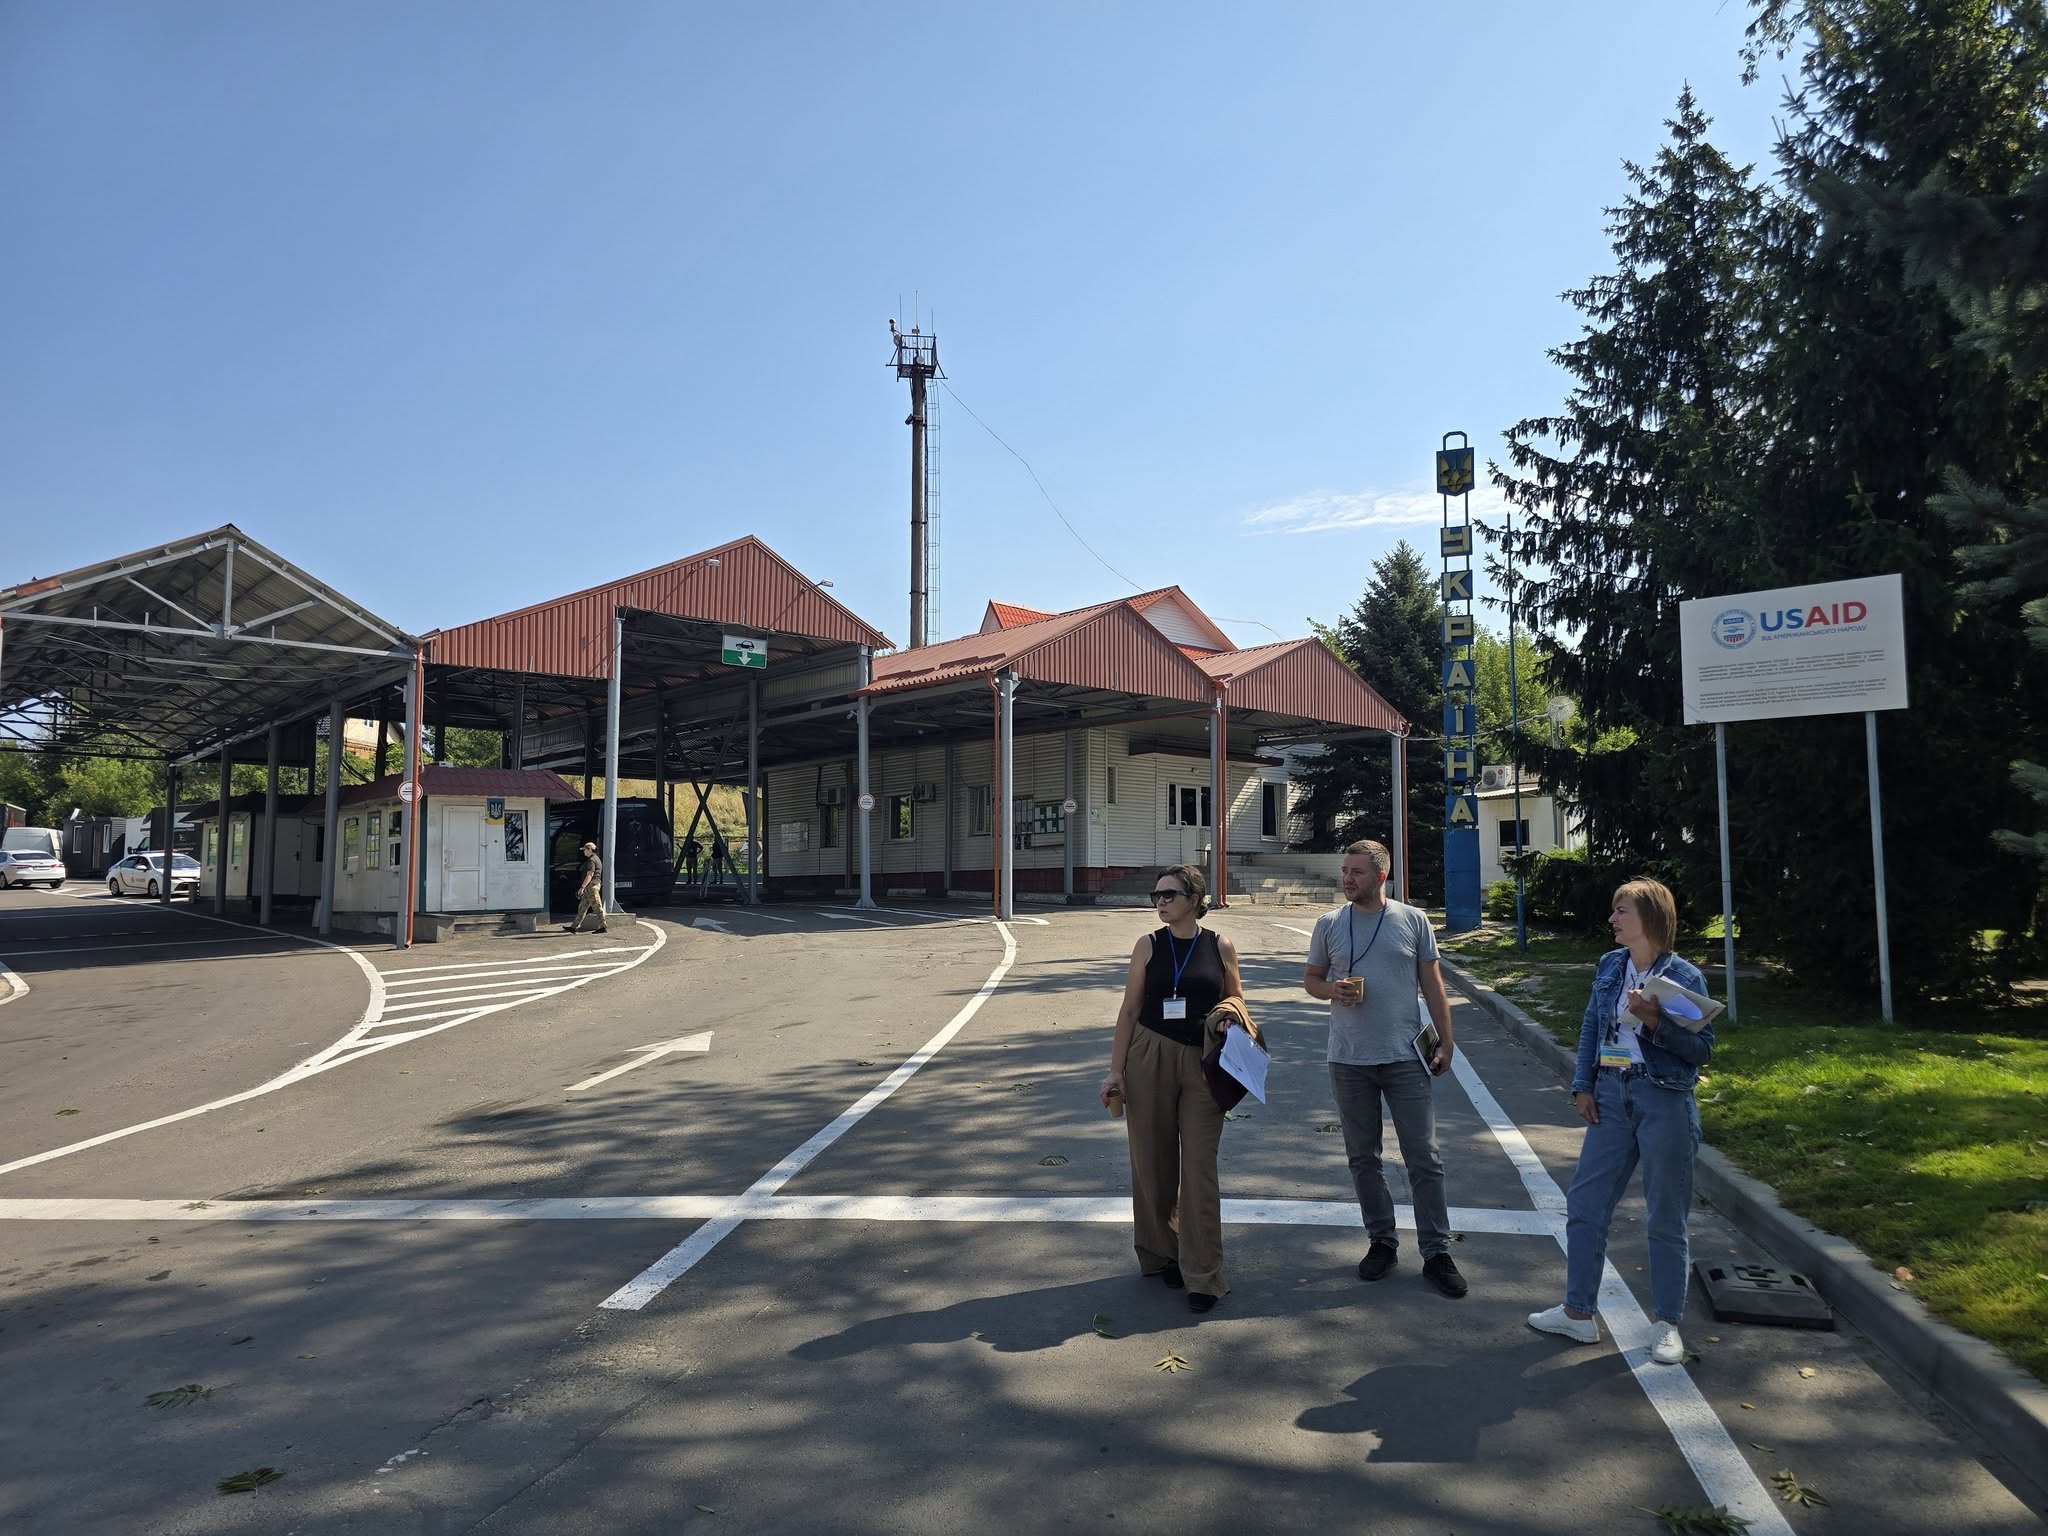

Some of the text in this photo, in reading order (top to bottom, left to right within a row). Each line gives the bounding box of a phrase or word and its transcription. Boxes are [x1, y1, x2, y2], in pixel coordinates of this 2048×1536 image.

[1760, 601, 1867, 632] USAID
[1773, 628, 1837, 640] АМЕРИКАНСЬКОГО
[1838, 624, 1867, 634] НАРОДУ
[1443, 527, 1475, 822] УКРАЇНА
